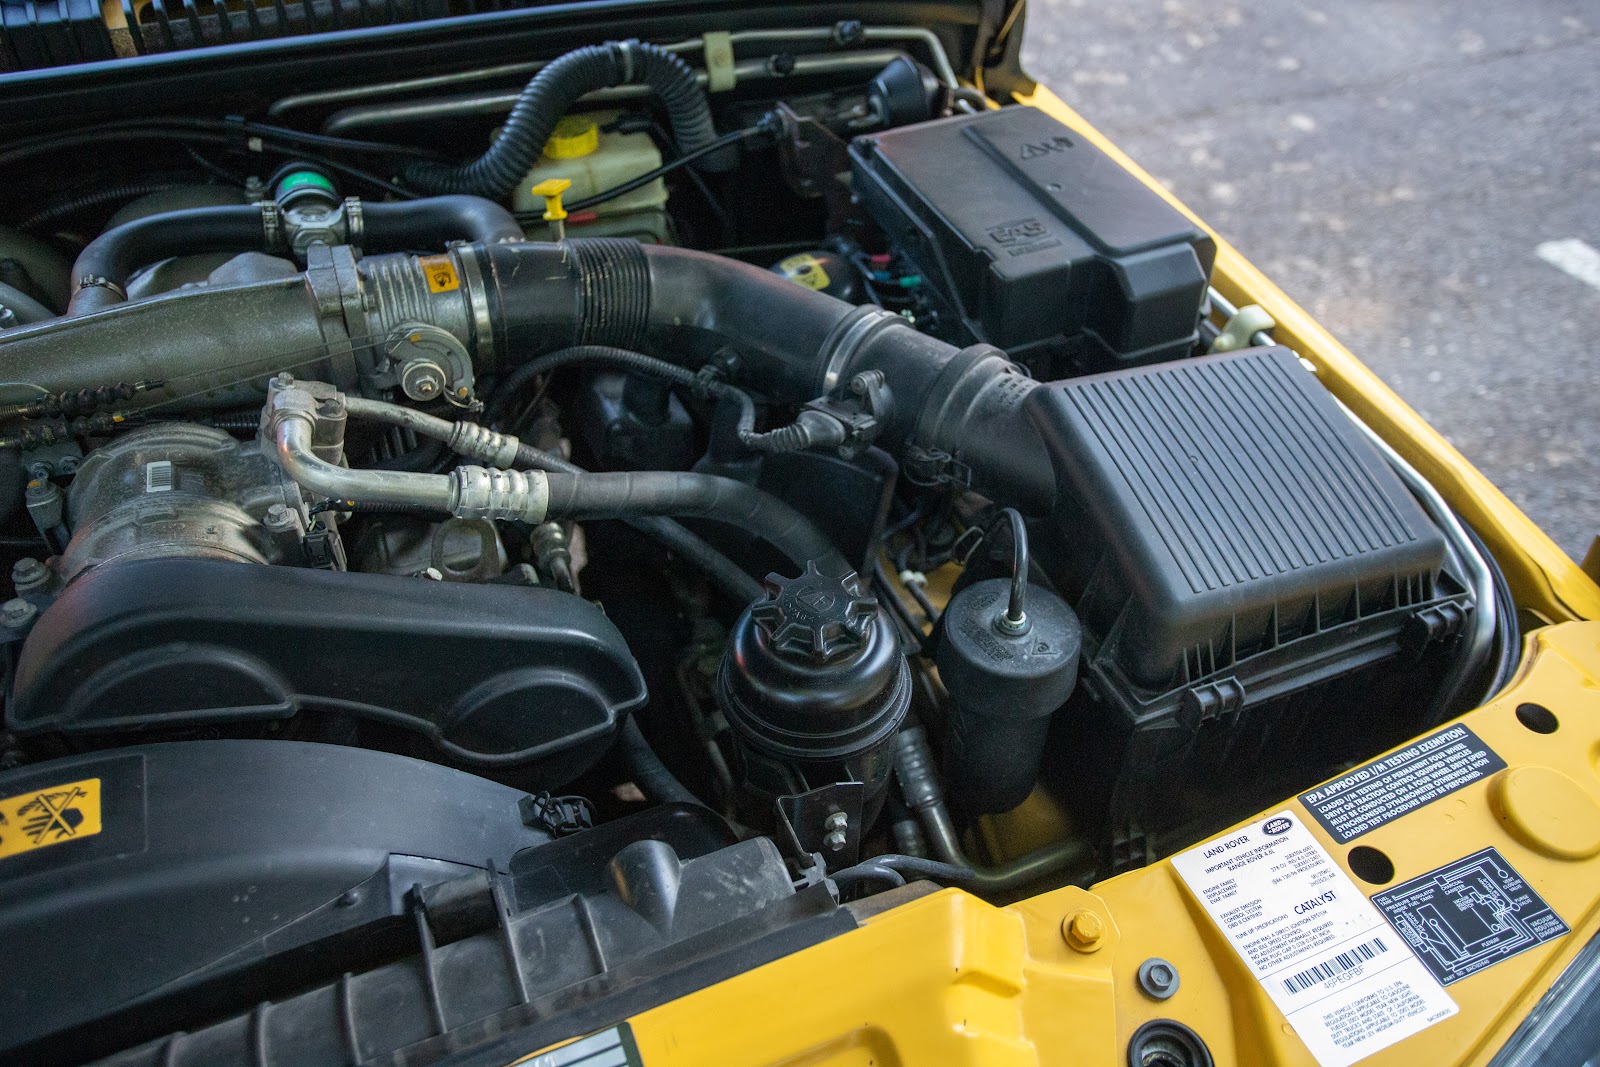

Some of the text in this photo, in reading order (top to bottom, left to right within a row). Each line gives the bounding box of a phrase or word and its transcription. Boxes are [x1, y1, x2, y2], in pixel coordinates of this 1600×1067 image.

[1305, 727, 1466, 803] EPA APPROVED I/M TESTING EXEMPTION
[1318, 742, 1466, 813] LOADED I/M TESTING OF PERMANENT FOUR WHEEL
[1323, 748, 1472, 819] DRIVE OR TRACTION CONTROL EQUIPPED VEHICLES
[1329, 813, 1350, 826] MUST
[1356, 792, 1397, 813] CONDUCTED
[1394, 786, 1408, 795] ON
[1412, 775, 1432, 787] FOUR
[1429, 766, 1452, 779] WHEEL
[1449, 758, 1470, 770] DRIVE
[1467, 750, 1487, 761] SPEED
[1335, 805, 1387, 832] SYNCHRONISED
[1384, 782, 1435, 809] DYNAMOMETER
[1432, 767, 1469, 786] OTHERWISE
[1472, 757, 1489, 768] NON
[1341, 822, 1369, 838] LOADED
[1366, 816, 1384, 826] TEST
[1381, 798, 1421, 820] PROCEDURE
[1418, 790, 1438, 802] MUST
[1444, 769, 1483, 790] PERFORMED.
[1264, 818, 1283, 829] LAND
[1270, 821, 1291, 833] ROVER
[1203, 834, 1250, 858] LAND ROVER
[1204, 858, 1234, 874] IMPORTANT
[1233, 850, 1254, 862] VEHICLE
[1253, 835, 1289, 853] INFORMATION
[1227, 860, 1246, 871] RANGE
[1245, 853, 1264, 863] ROVER
[1262, 848, 1275, 856] 4.6L
[1205, 883, 1238, 899] DISPLACEMENT
[1219, 877, 1236, 887] FAMILY
[1440, 879, 1463, 890] CHARCOAL
[1444, 883, 1466, 895] CANISTER
[1221, 889, 1238, 899] FAMILY
[1292, 890, 1338, 915] CATALYST
[1409, 888, 1435, 900] REGULATOR
[1219, 898, 1262, 919] EXHAUST EMISSION
[1223, 904, 1262, 924] CONTROL SYSTEM
[1241, 910, 1263, 923] CERTIFIED
[1242, 939, 1261, 949] ENGINE
[1274, 926, 1290, 935] DIRECT
[1289, 916, 1311, 929] IGNITION
[1310, 909, 1328, 919] SYSTEM
[1254, 913, 1289, 931] SPECIFICATIONS
[1529, 914, 1554, 927] VACUUM
[1533, 918, 1559, 932] ROUTING
[1538, 923, 1564, 937] DIAGRAM
[1258, 940, 1288, 956] ADJUSTMENT
[1287, 930, 1312, 943] NORMALLY
[1311, 920, 1334, 933] REQUIRED
[1267, 936, 1282, 945] SPEED
[1280, 927, 1302, 939] CONTROL
[1480, 936, 1501, 947] PLENUM
[1254, 956, 1269, 965] SPARK
[1269, 950, 1282, 959] PLUG
[1266, 957, 1283, 967] OTHER
[1282, 943, 1314, 960] ADJUSTMENTS
[1312, 934, 1336, 946] REQUIRED
[1320, 964, 1367, 990] 46PEGFBF
[1442, 974, 1455, 982] PART
[1324, 1009, 1356, 1027] REGULATIONS
[1354, 997, 1381, 1012] APPLICABLE
[1386, 983, 1411, 997] GASOLINE
[1333, 1004, 1351, 1015] VEHICLE
[1350, 992, 1378, 1007] CONFORMS
[1392, 994, 1420, 1009] CALIFORNIA
[1358, 1007, 1376, 1018] MODEL
[1332, 1027, 1366, 1045] REGULATIONS
[1364, 1015, 1391, 1030] APPLICABLE
